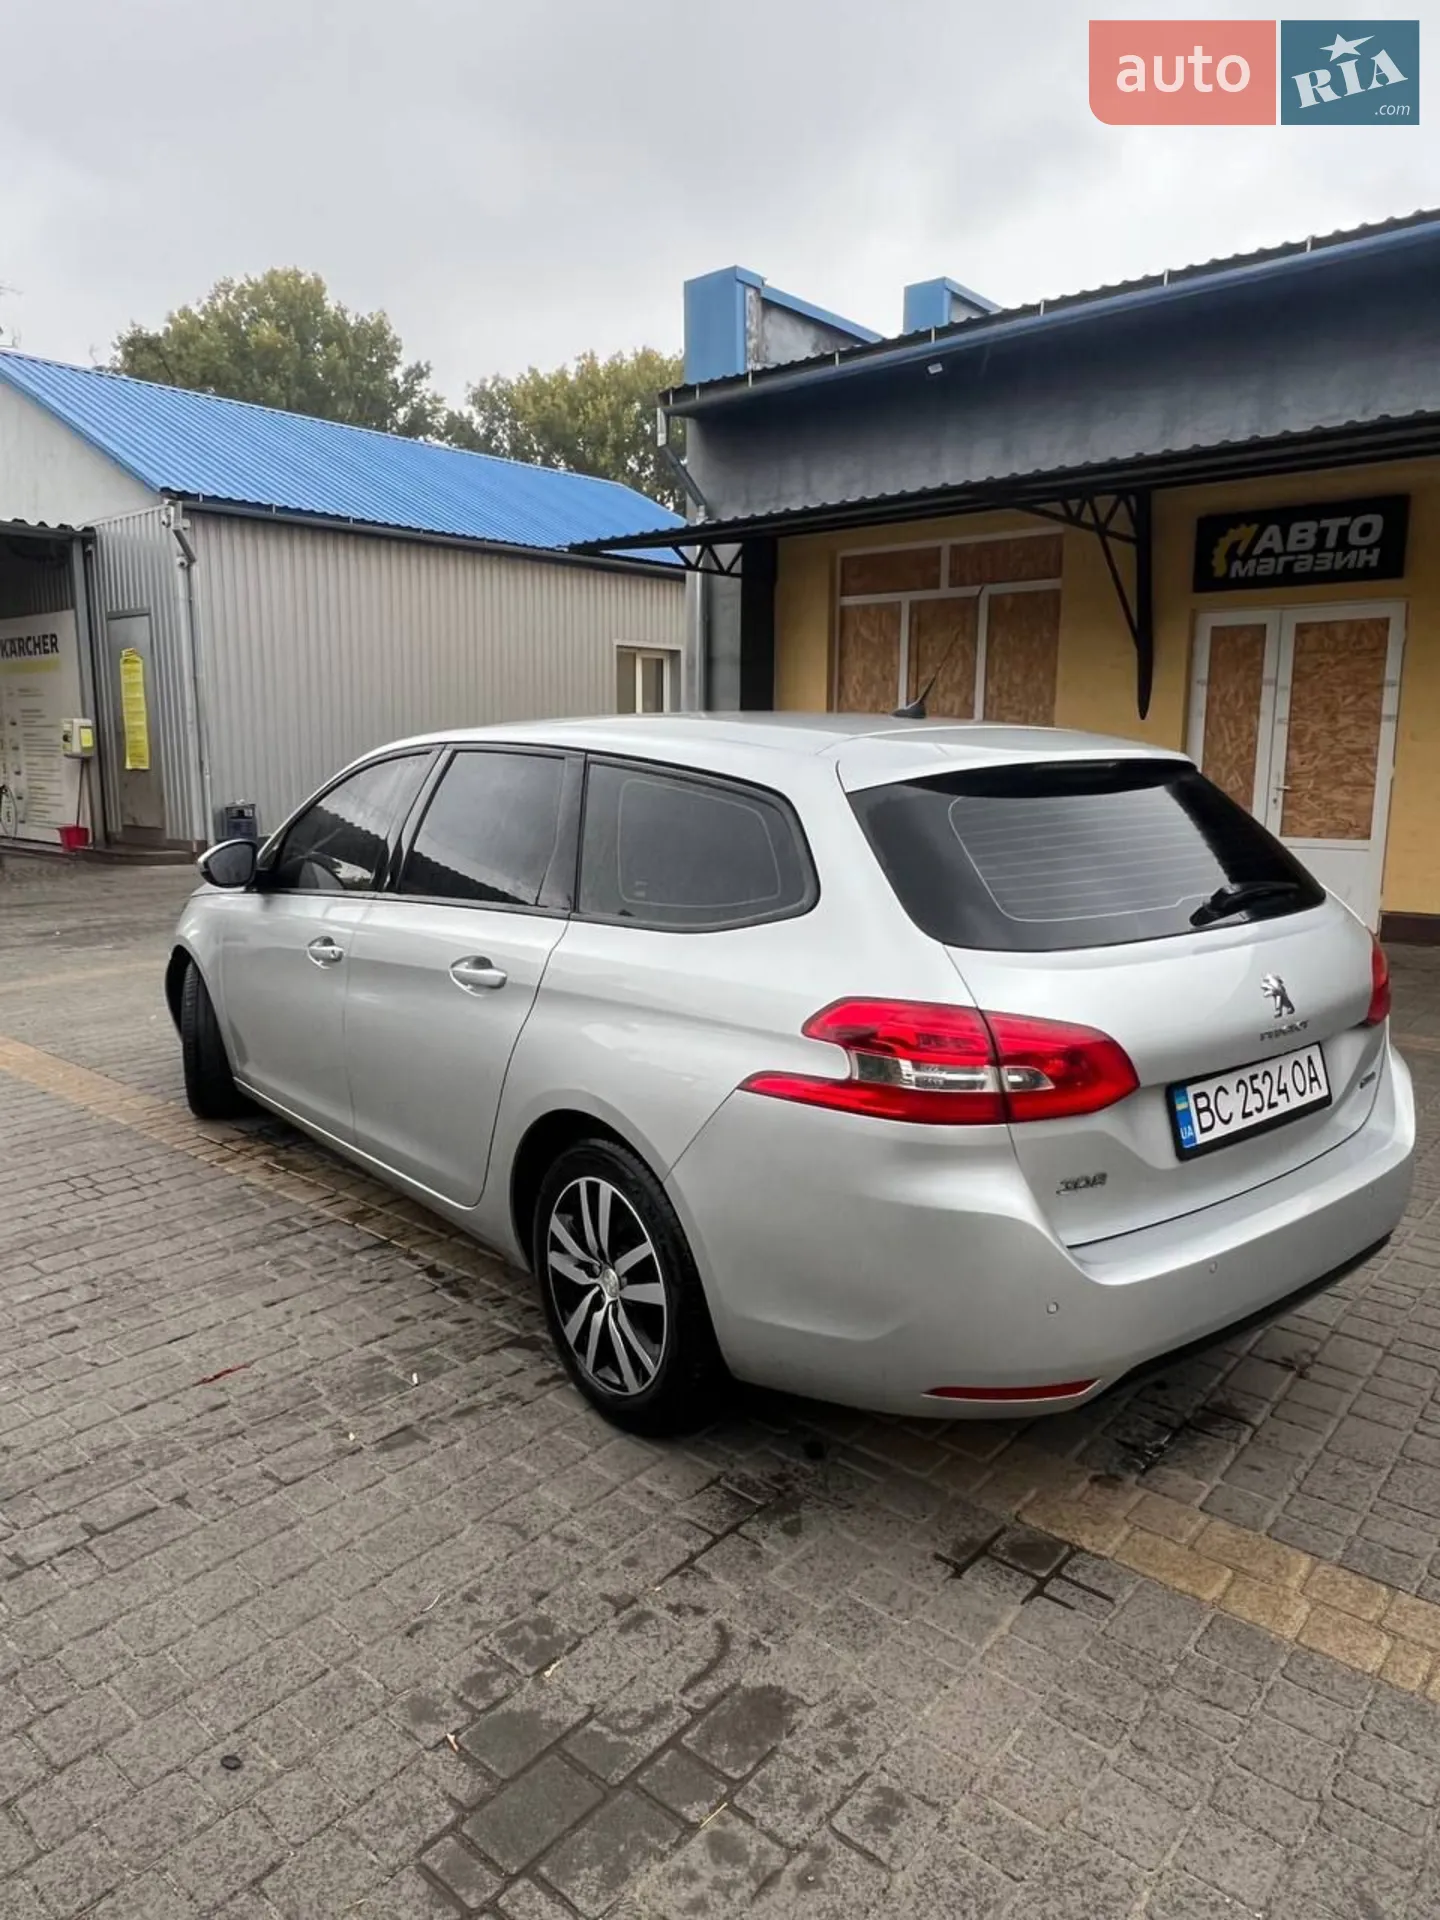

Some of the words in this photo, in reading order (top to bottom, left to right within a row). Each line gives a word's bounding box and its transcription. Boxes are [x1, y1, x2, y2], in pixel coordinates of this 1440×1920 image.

[1252, 514, 1384, 554] АВТО
[1229, 548, 1380, 578] магазин
[1193, 1087, 1233, 1133] BC
[1236, 1071, 1289, 1119] 2524
[1292, 1055, 1321, 1098] OA
[1180, 1127, 1194, 1140] UA
